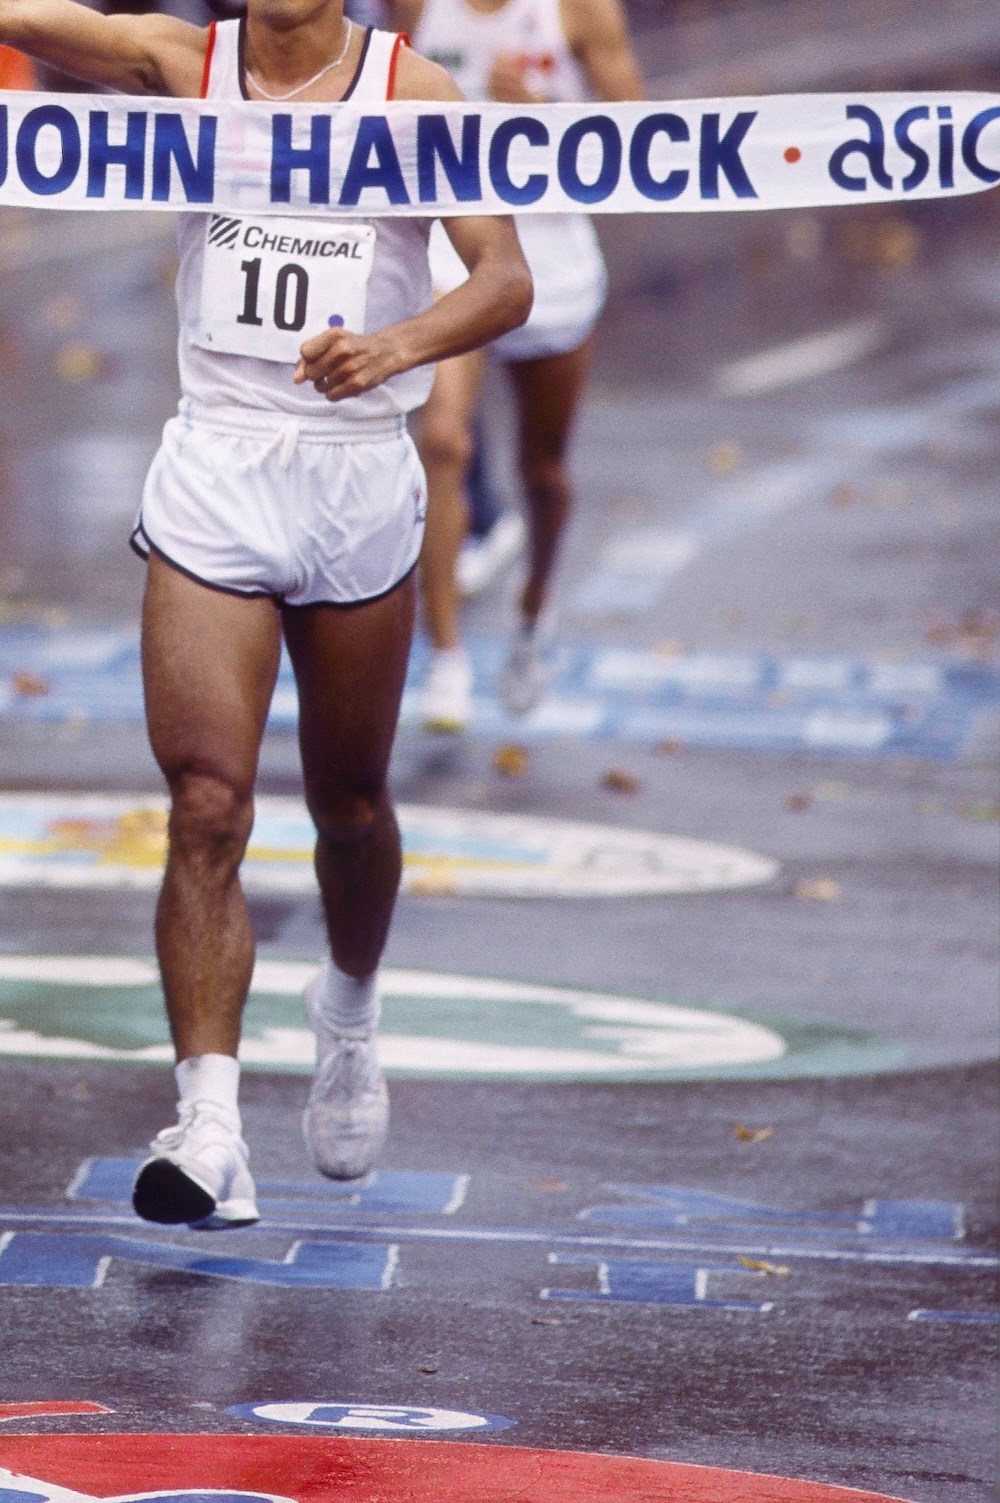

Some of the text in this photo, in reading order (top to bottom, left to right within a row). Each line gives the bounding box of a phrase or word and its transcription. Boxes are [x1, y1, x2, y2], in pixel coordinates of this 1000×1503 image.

[269, 109, 759, 207] HANCOCK
[242, 225, 364, 260] CHEMICAL
[236, 256, 310, 333] 10
